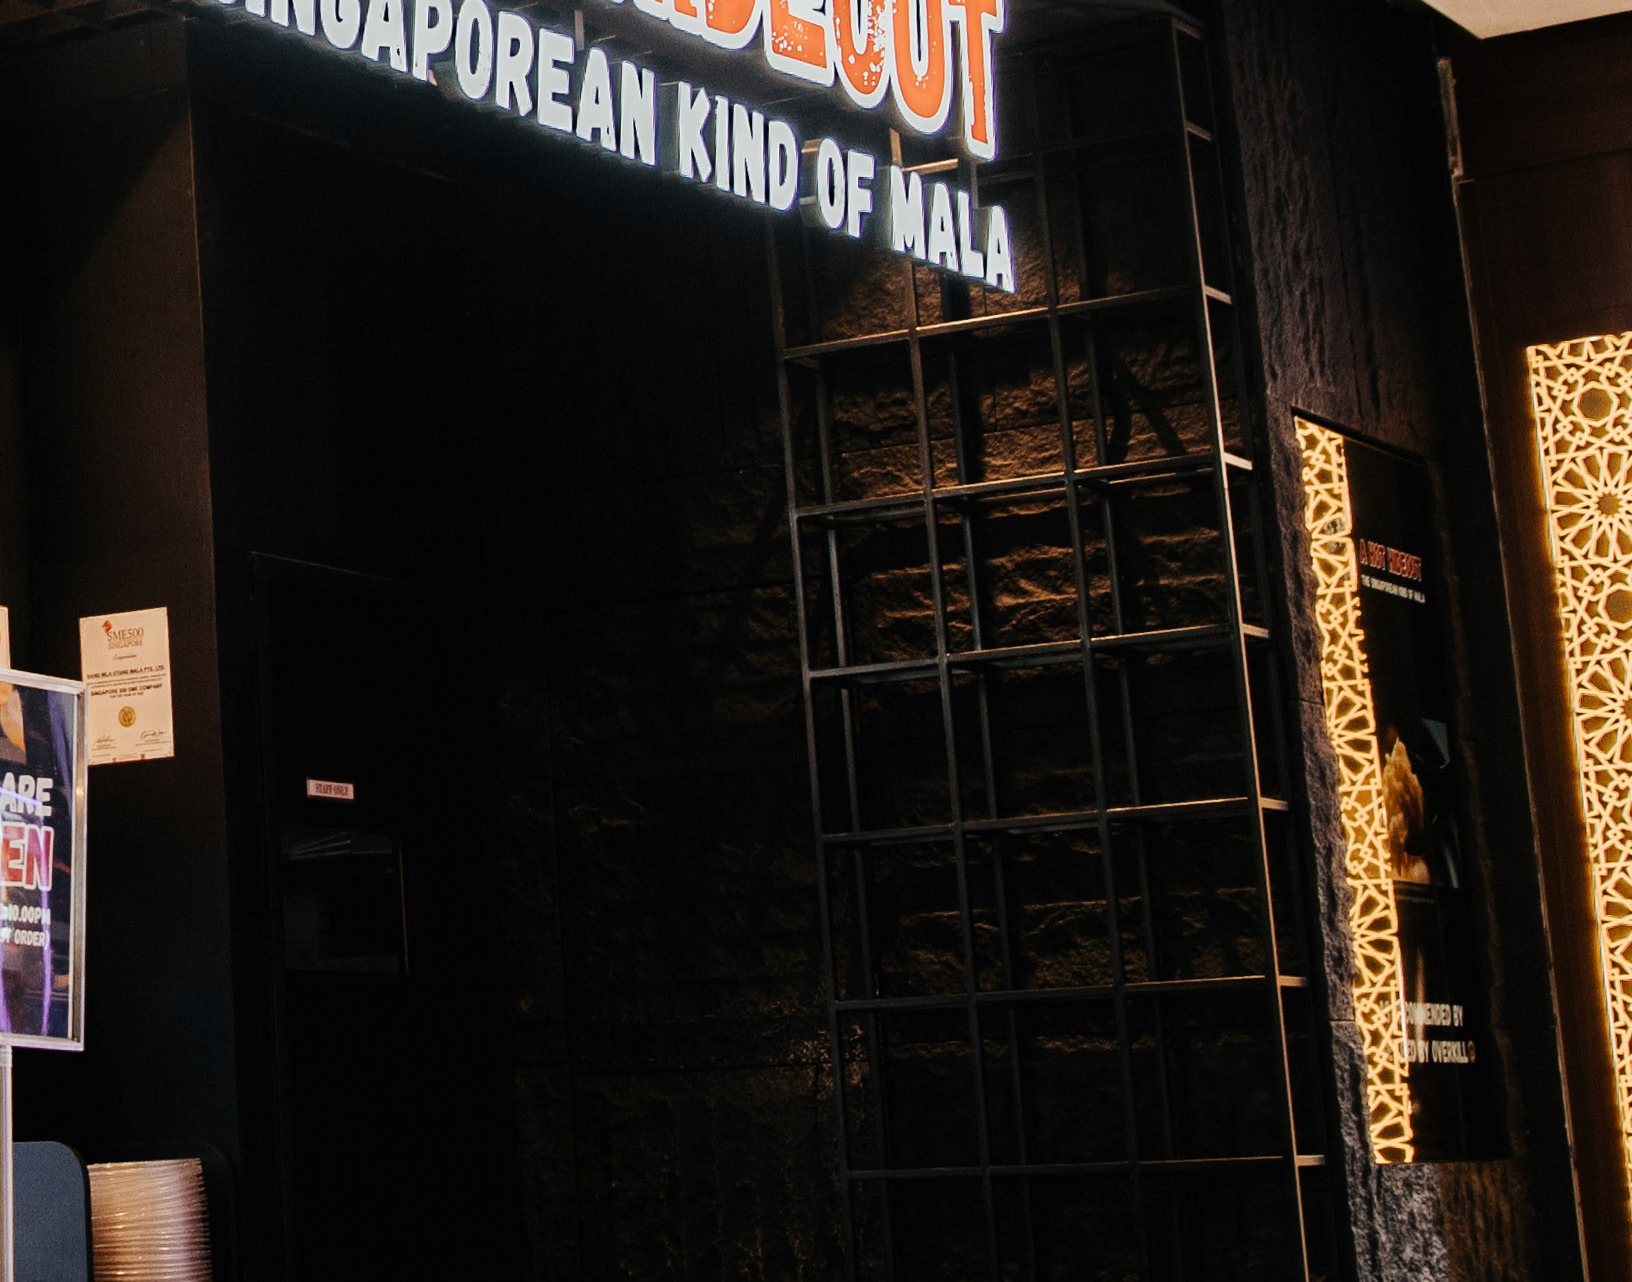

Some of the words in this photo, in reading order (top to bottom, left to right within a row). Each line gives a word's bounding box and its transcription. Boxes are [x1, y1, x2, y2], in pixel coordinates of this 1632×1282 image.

[677, 80, 798, 211] KIND
[817, 147, 874, 238] OF
[890, 164, 1014, 293] MALA
[107, 628, 144, 642] SME500
